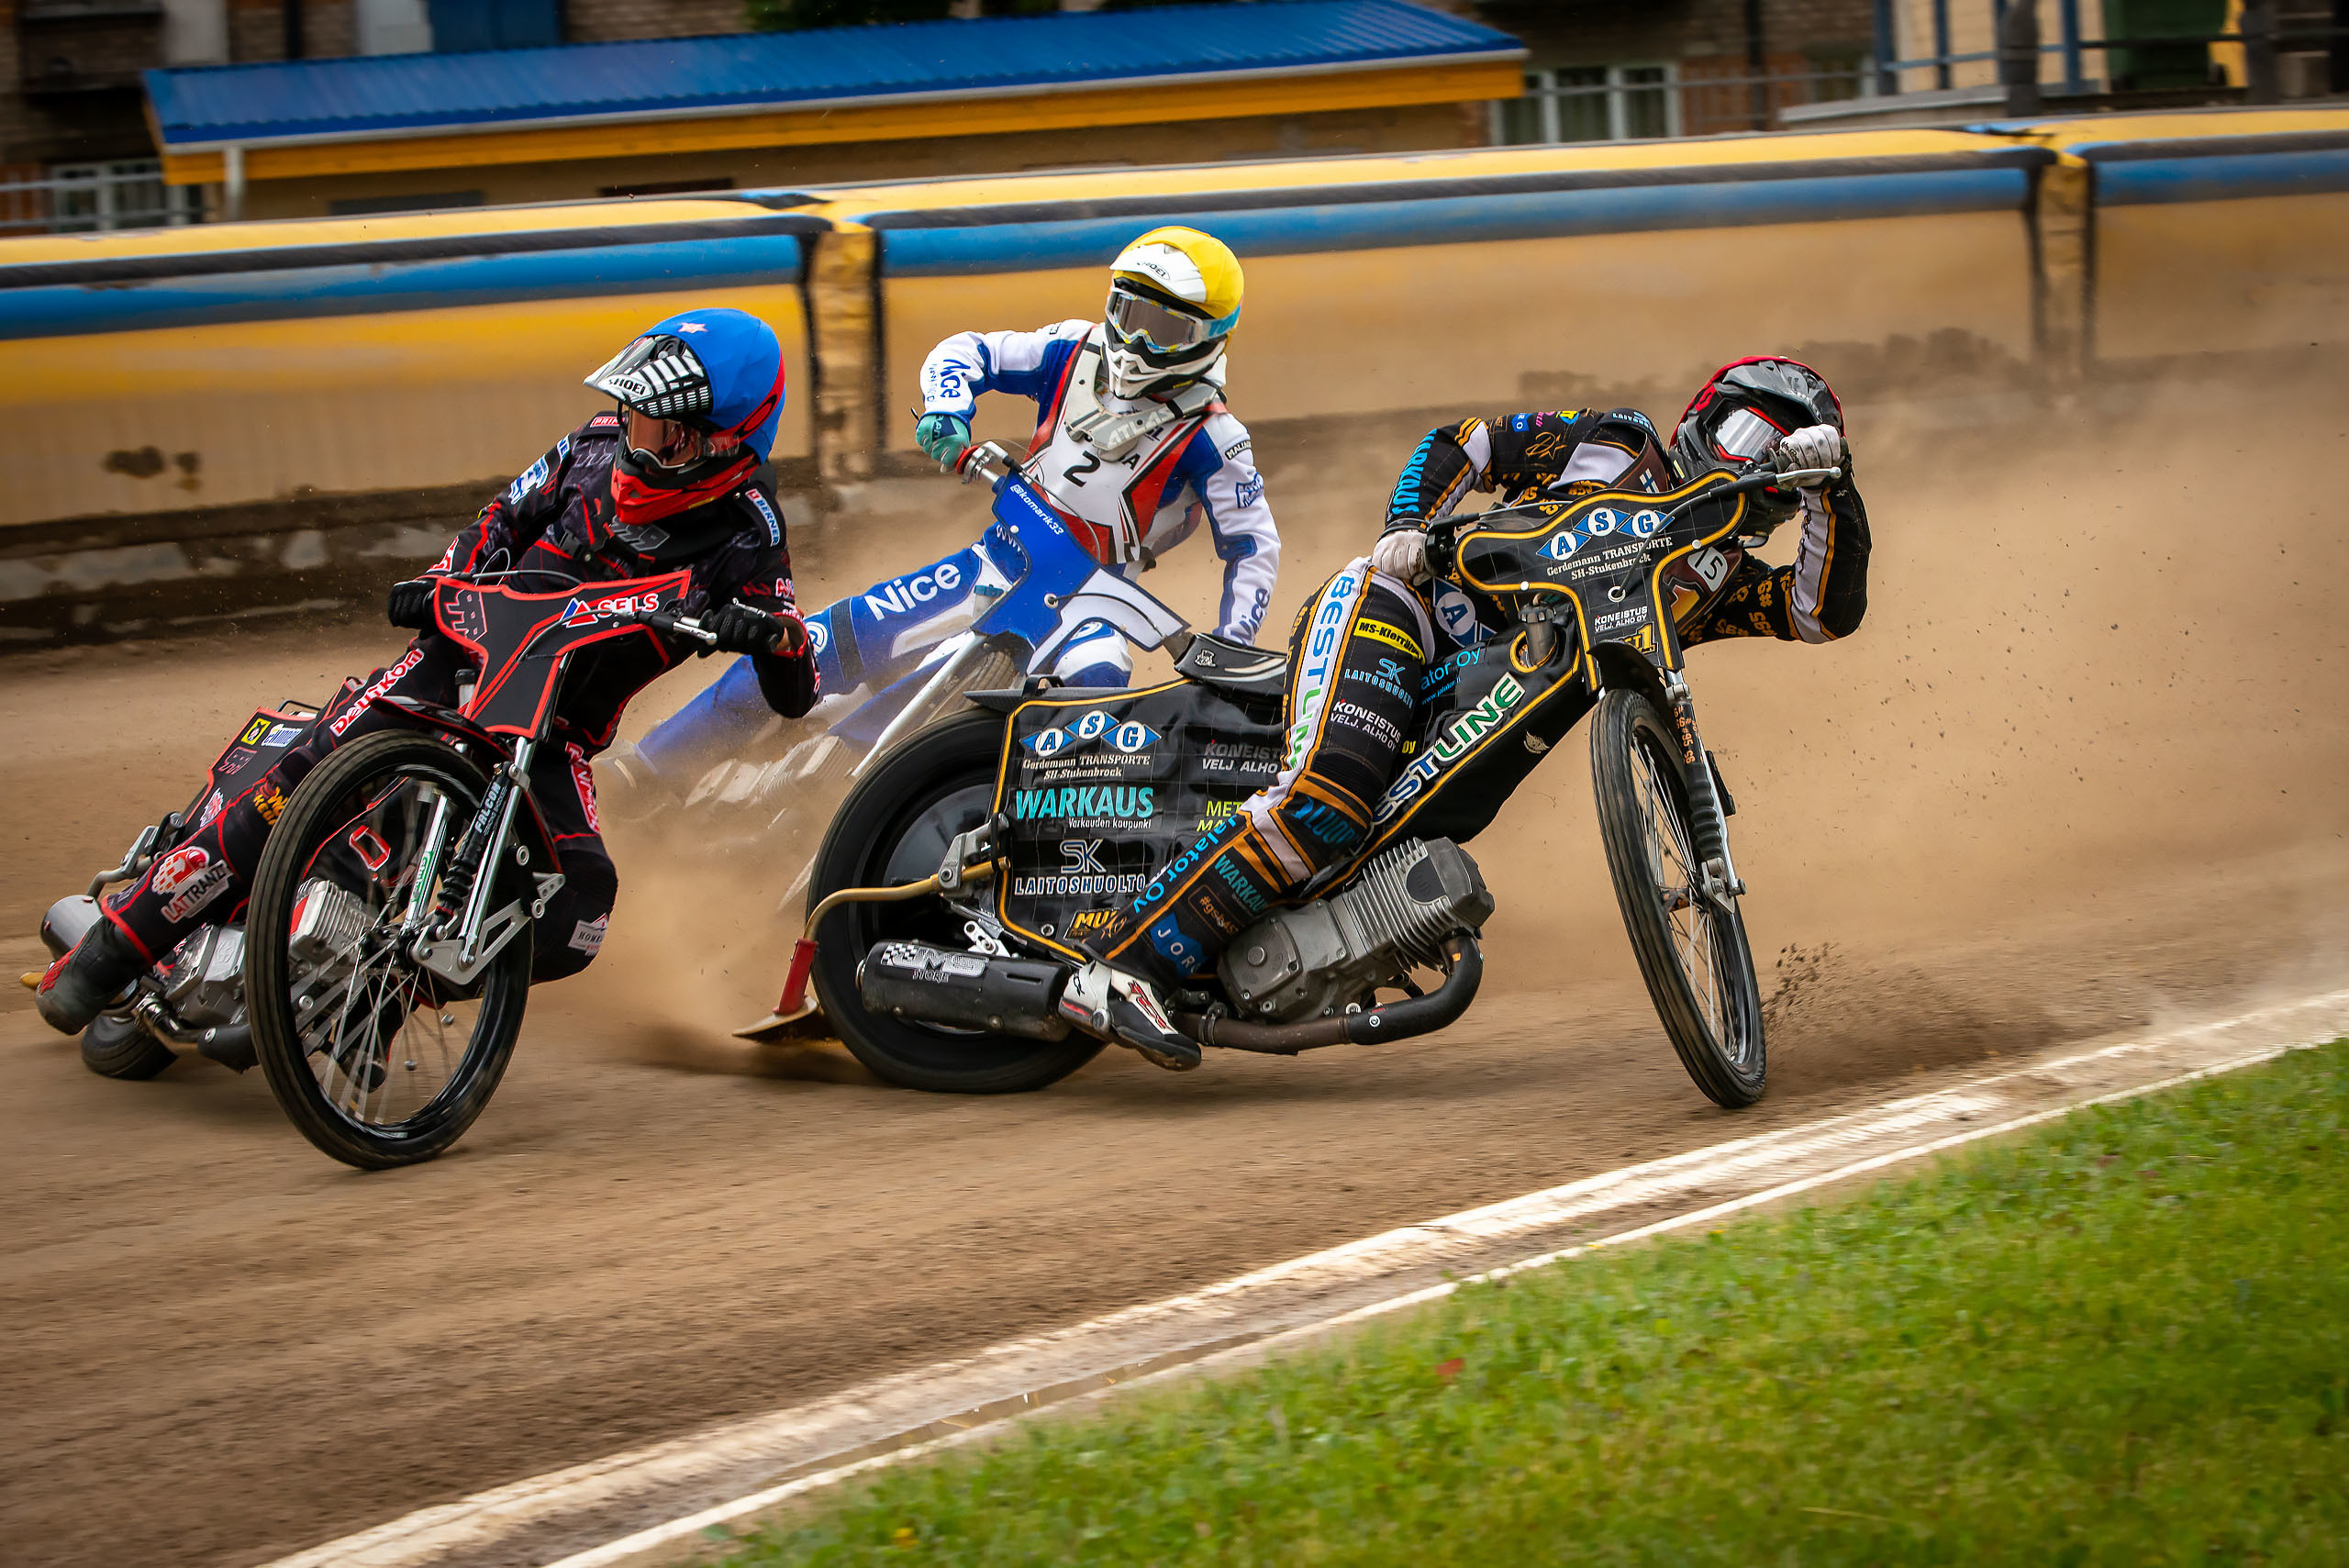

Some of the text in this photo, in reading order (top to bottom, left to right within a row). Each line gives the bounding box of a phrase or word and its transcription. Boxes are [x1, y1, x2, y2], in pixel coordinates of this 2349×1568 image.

[608, 377, 646, 395] SHOEI
[940, 359, 971, 398] Nice
[1063, 450, 1101, 488] 2
[756, 498, 780, 545] BERNER
[1009, 484, 1064, 536] @komarik33
[1546, 554, 1601, 577] Gerdemann
[863, 563, 962, 622] Nice
[1230, 587, 1270, 647] Nice
[1594, 606, 1648, 627] KONEISTUS
[1615, 617, 1636, 629] ALHO
[1636, 614, 1648, 623] OY
[1376, 658, 1405, 685] SK
[1420, 646, 1481, 690] ator Oy
[1330, 713, 1397, 751] VELJ. ALHO OY
[1333, 699, 1401, 744] KONEISTUS
[1023, 754, 1151, 770] Gerdemann TRANSPORTE
[1043, 767, 1123, 781] SH-Stukenbrock
[1240, 761, 1279, 774] ALHO
[474, 782, 503, 834] FALCON
[1016, 786, 1154, 820] WARKAUS
[1068, 817, 1152, 831] Varkauden kaupunki
[1059, 839, 1108, 874] SK
[1013, 873, 1146, 896] LAITOSHUOLTO
[1213, 853, 1269, 913] WARKAU
